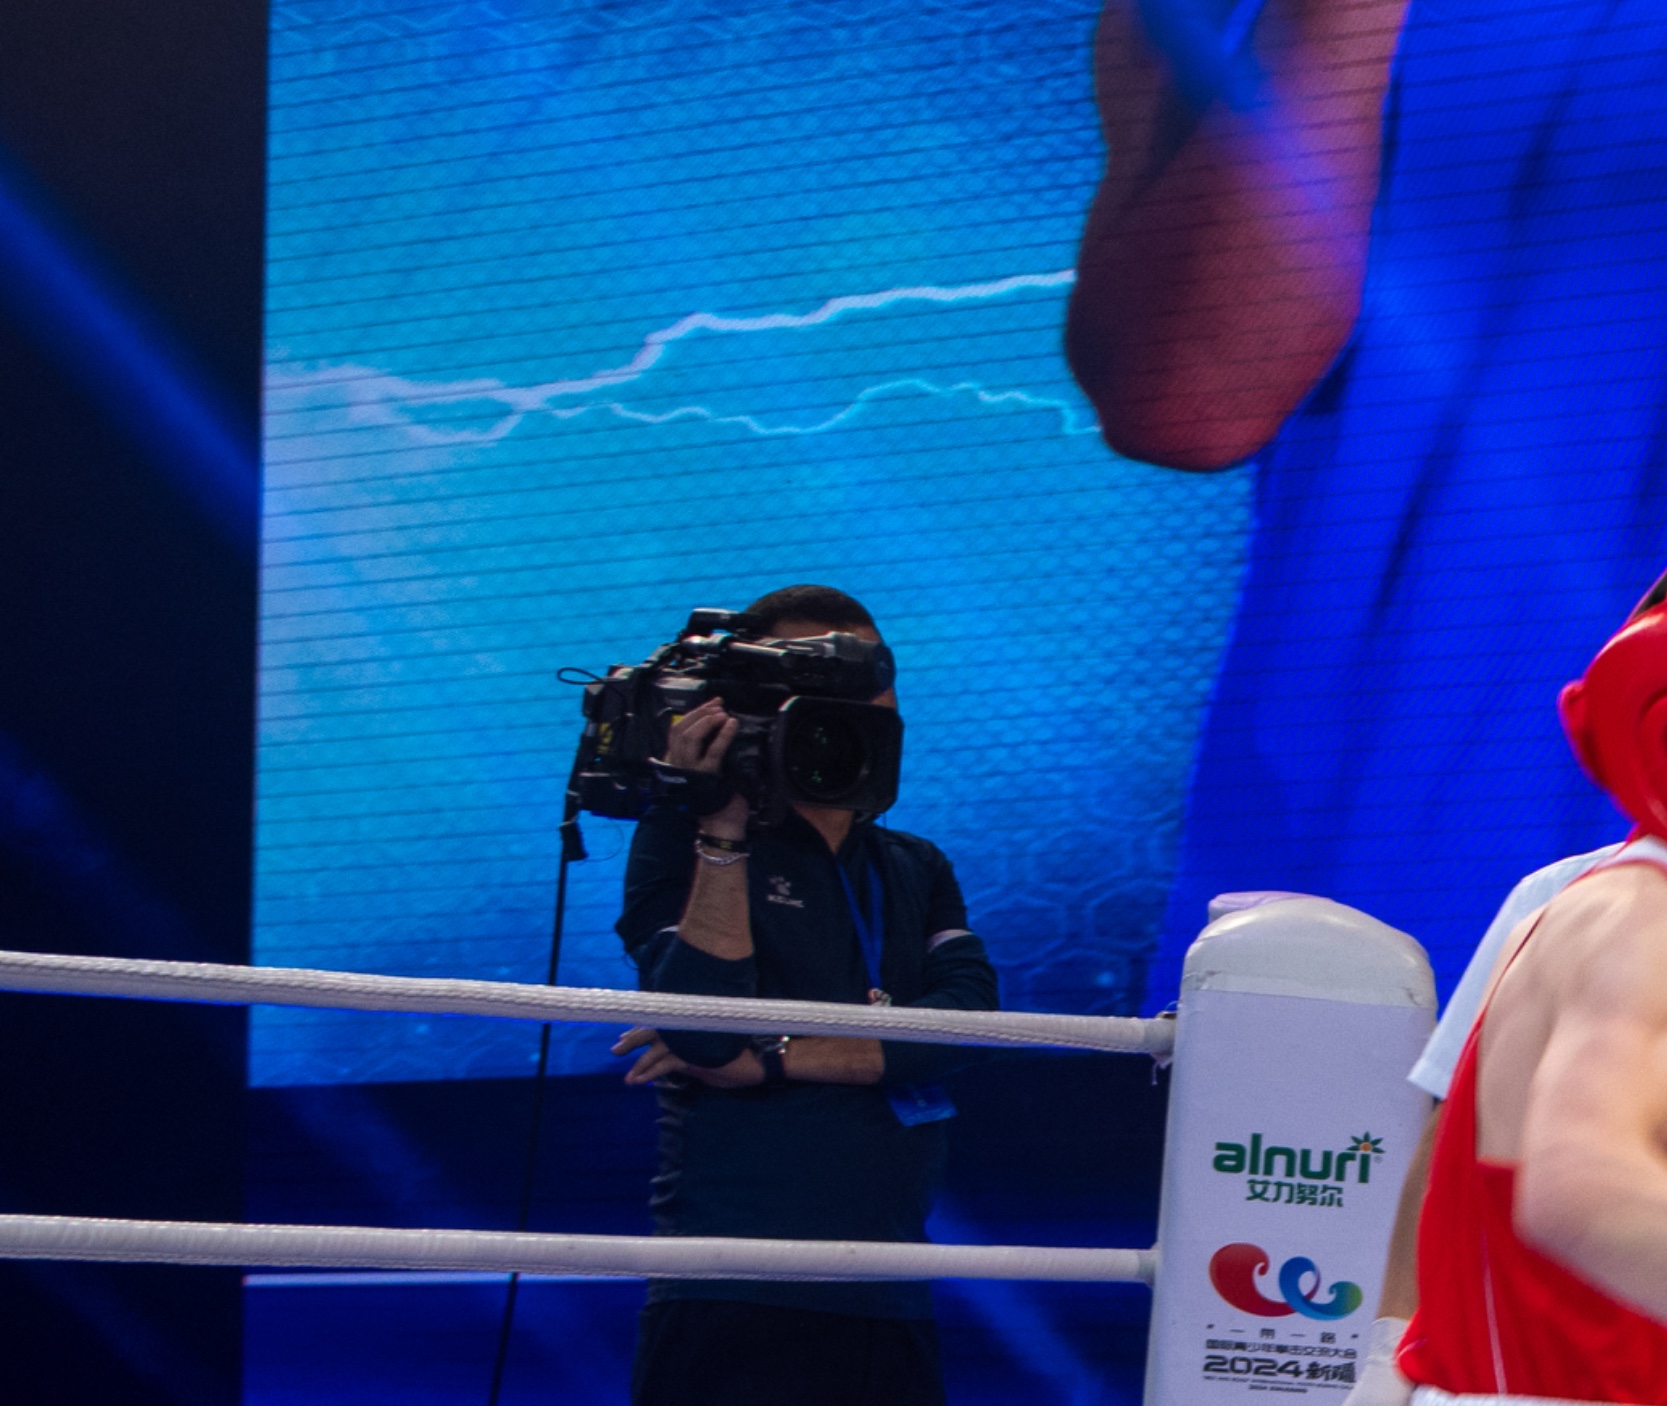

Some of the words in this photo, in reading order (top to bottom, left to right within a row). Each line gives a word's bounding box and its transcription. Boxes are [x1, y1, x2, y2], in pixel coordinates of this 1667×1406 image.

[1213, 1132, 1384, 1184] alnuri
[1246, 1179, 1343, 1207] 艾力努尔
